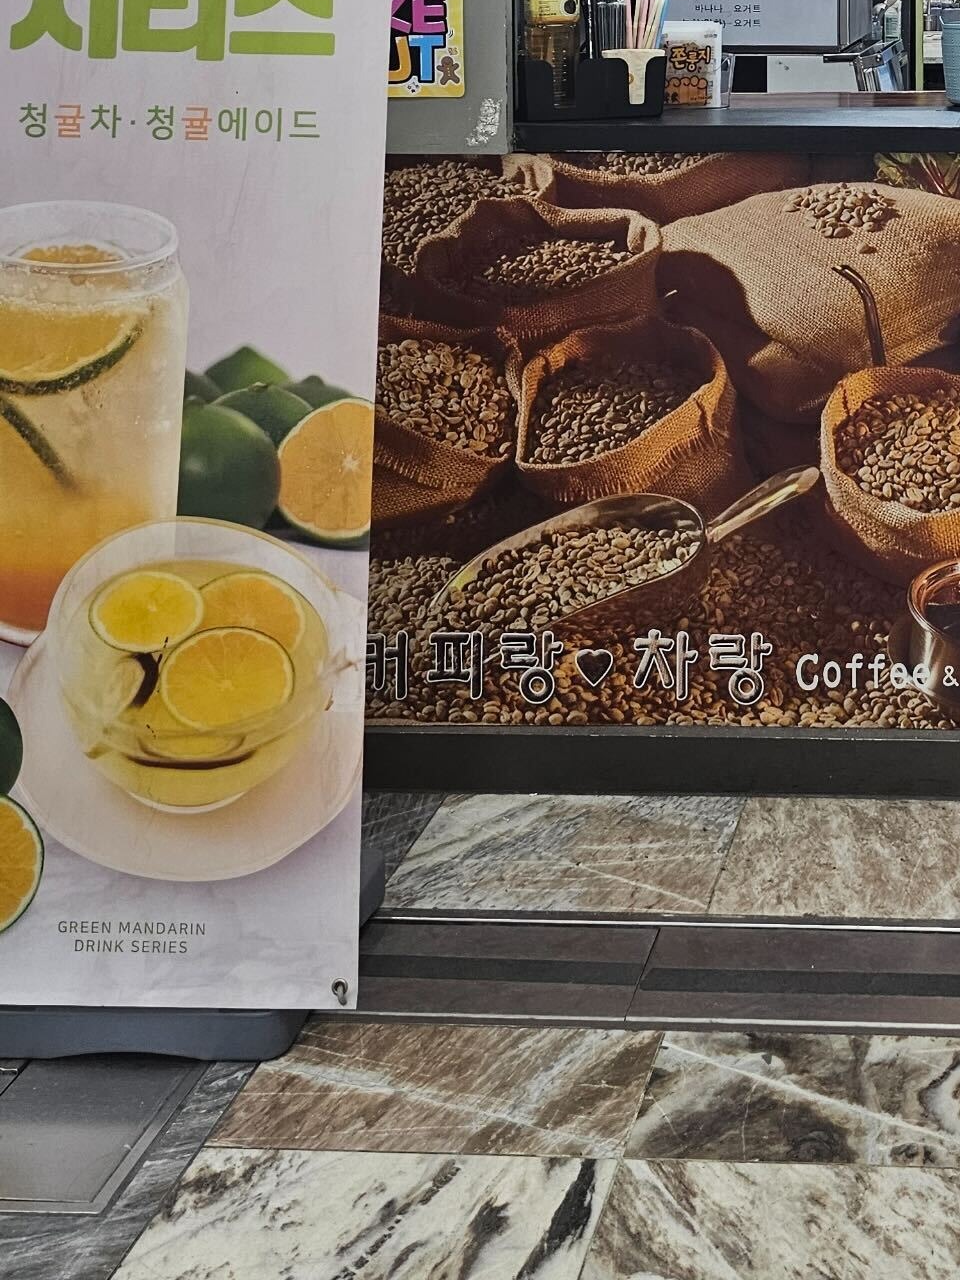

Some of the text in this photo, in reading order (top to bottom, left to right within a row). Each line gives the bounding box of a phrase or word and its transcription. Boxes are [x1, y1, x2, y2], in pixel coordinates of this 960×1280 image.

[695, 4, 761, 13] 바나나 요거트
[733, 19, 761, 28] 요거트
[633, 628, 773, 706] 차랑
[796, 652, 931, 691] Coffee
[942, 665, 960, 687] &
[57, 920, 207, 936] GREEN MANDARIN
[74, 939, 189, 954] DRINK SERIES
